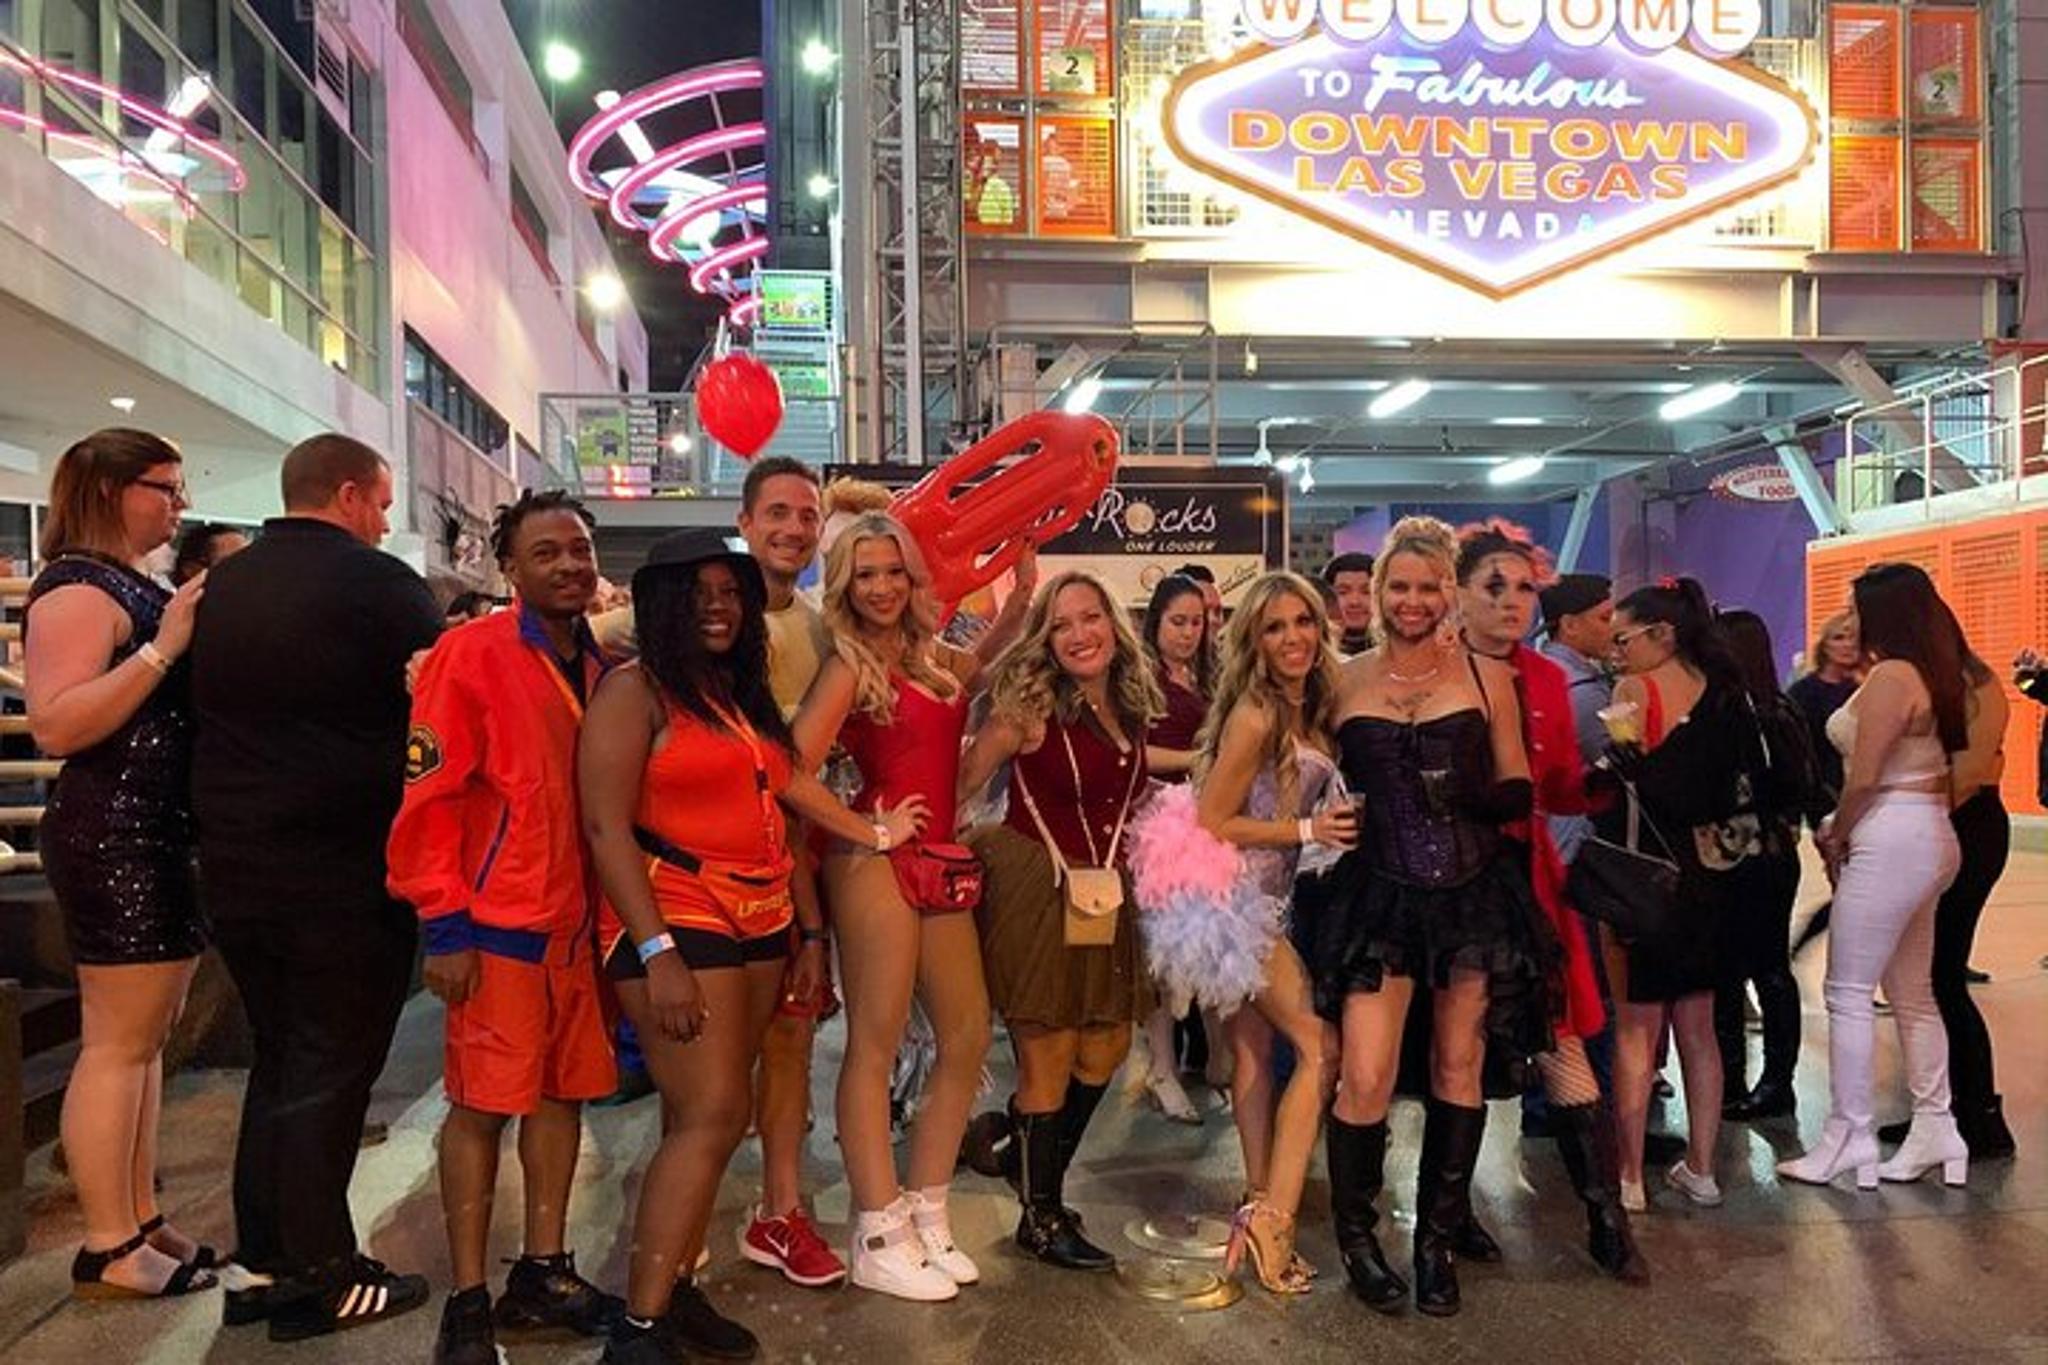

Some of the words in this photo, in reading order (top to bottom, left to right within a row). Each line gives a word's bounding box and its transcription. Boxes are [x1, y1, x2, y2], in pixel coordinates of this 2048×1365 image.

[1259, 0, 1743, 34] WELCOME
[1065, 56, 1079, 75] 2
[1297, 67, 1351, 98] TO
[1363, 53, 1647, 112] Fabulous
[1228, 109, 1748, 162] DOWNTOWN
[1294, 156, 1426, 198] LAS
[1449, 160, 1688, 202] VEGAS
[1386, 208, 1598, 240] NEVADA
